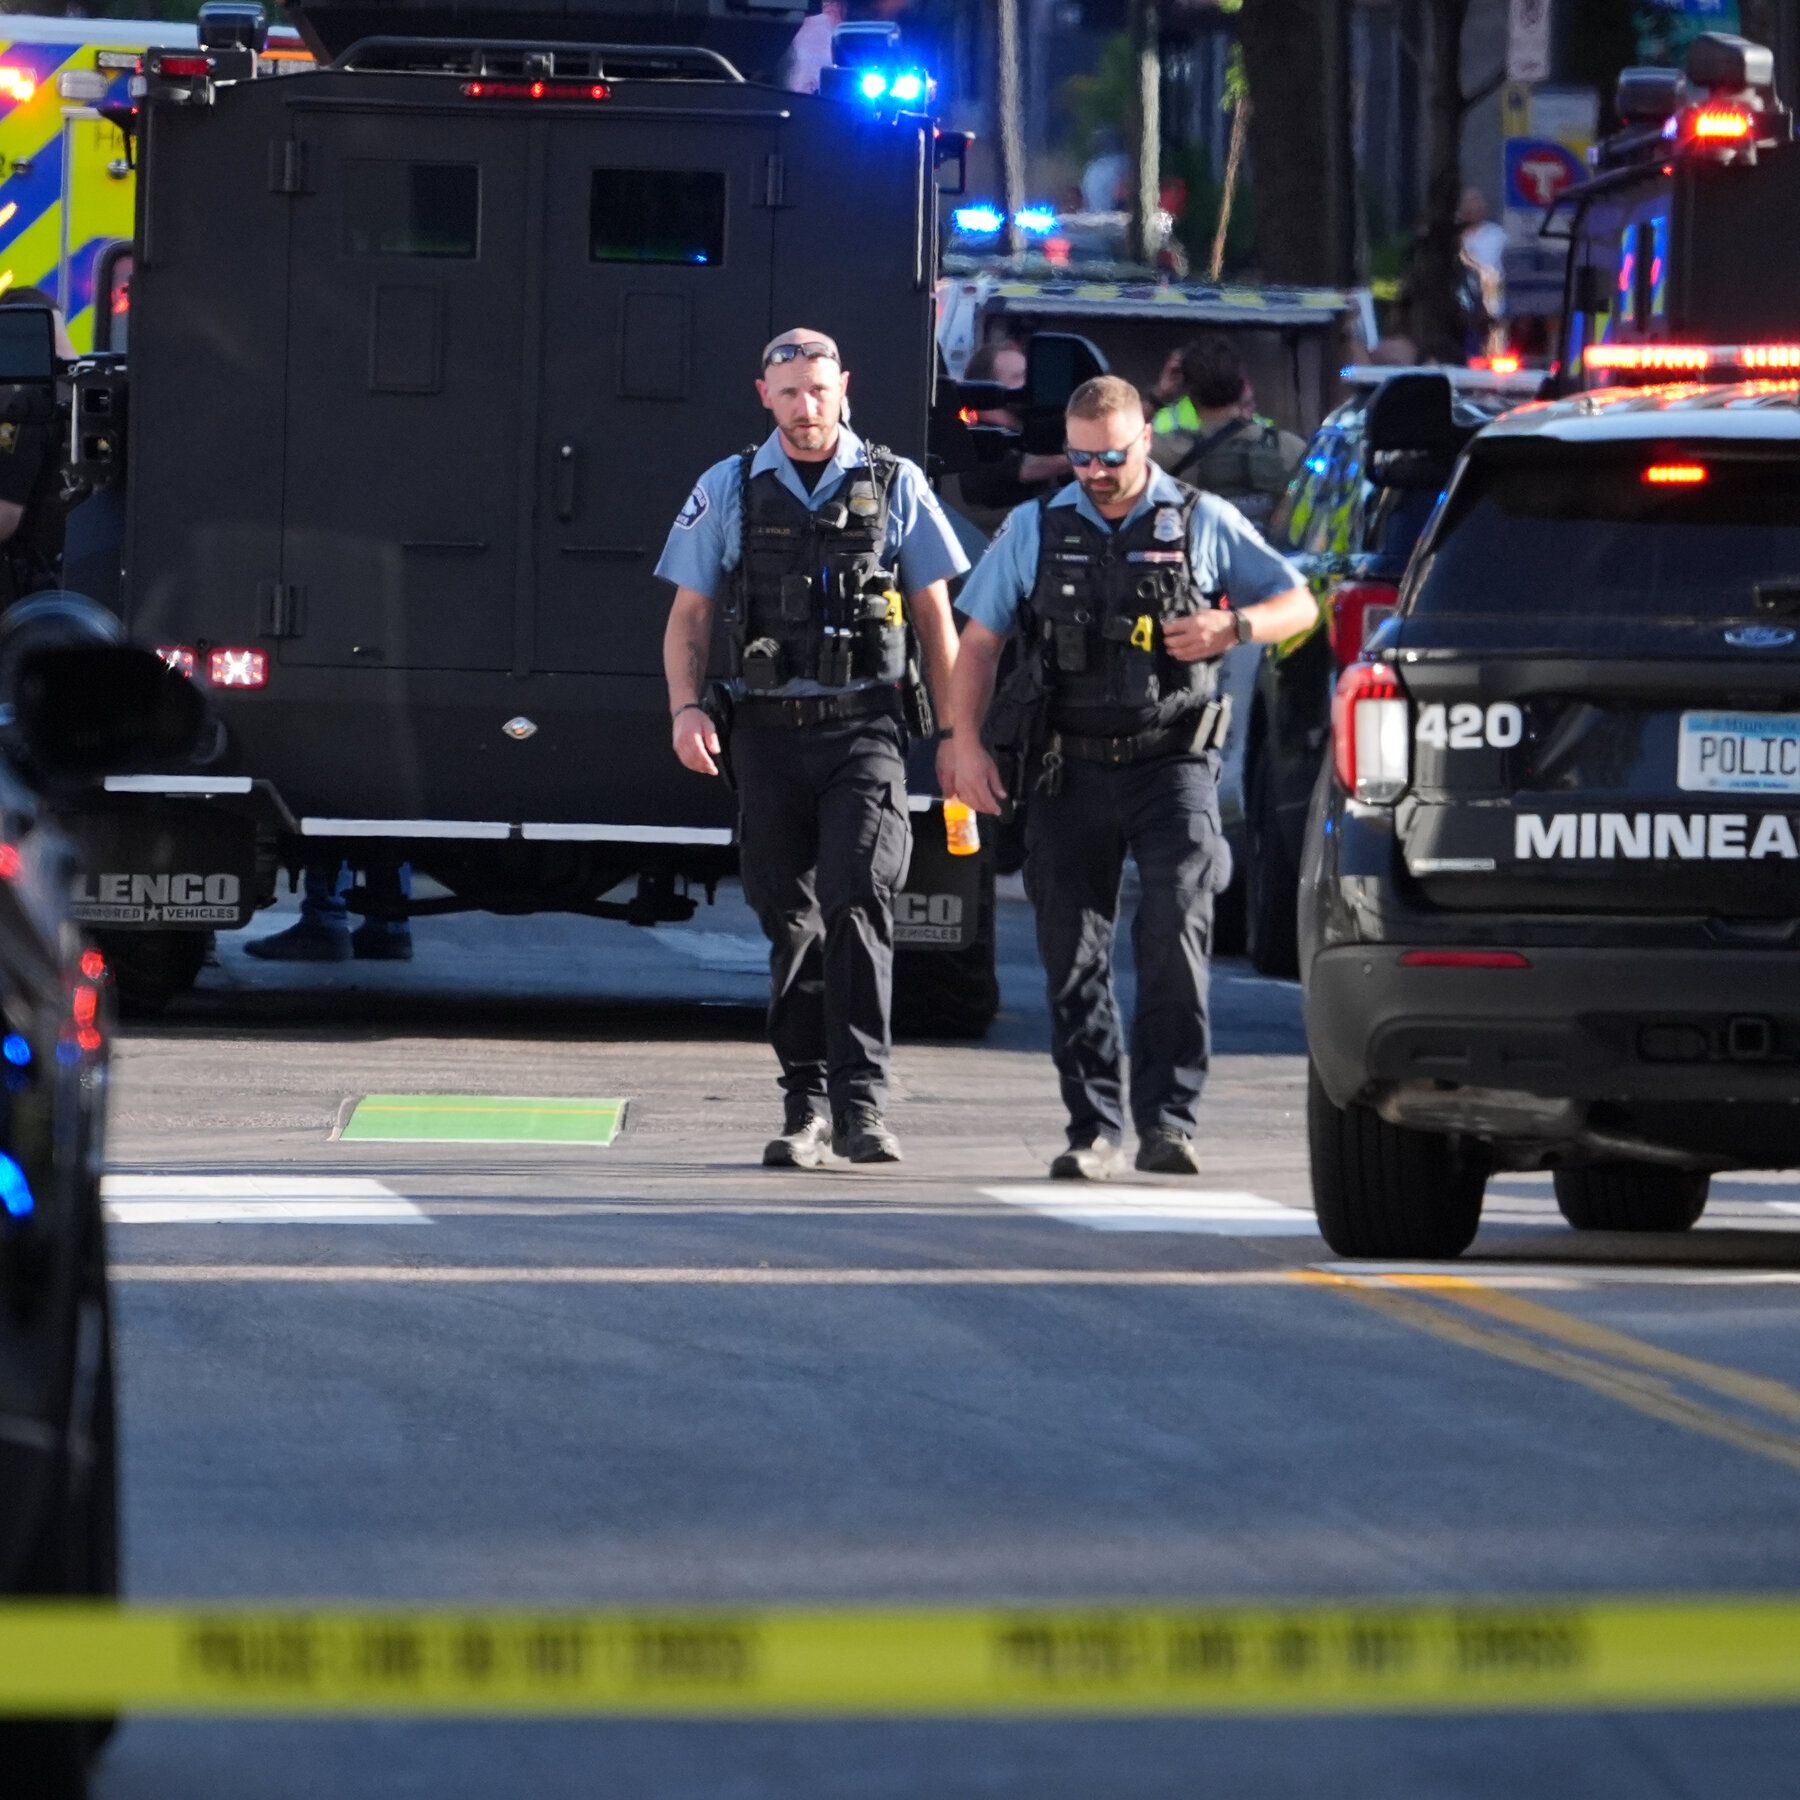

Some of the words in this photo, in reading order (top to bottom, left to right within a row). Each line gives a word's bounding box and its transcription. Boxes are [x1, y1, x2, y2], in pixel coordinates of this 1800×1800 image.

[1415, 702, 1522, 750] 420
[1700, 736, 1800, 775] POLIC
[1514, 813, 1799, 859] MINNEA
[70, 873, 241, 905] LENCO
[167, 908, 235, 919] VEHICLES
[887, 892, 963, 925] CO
